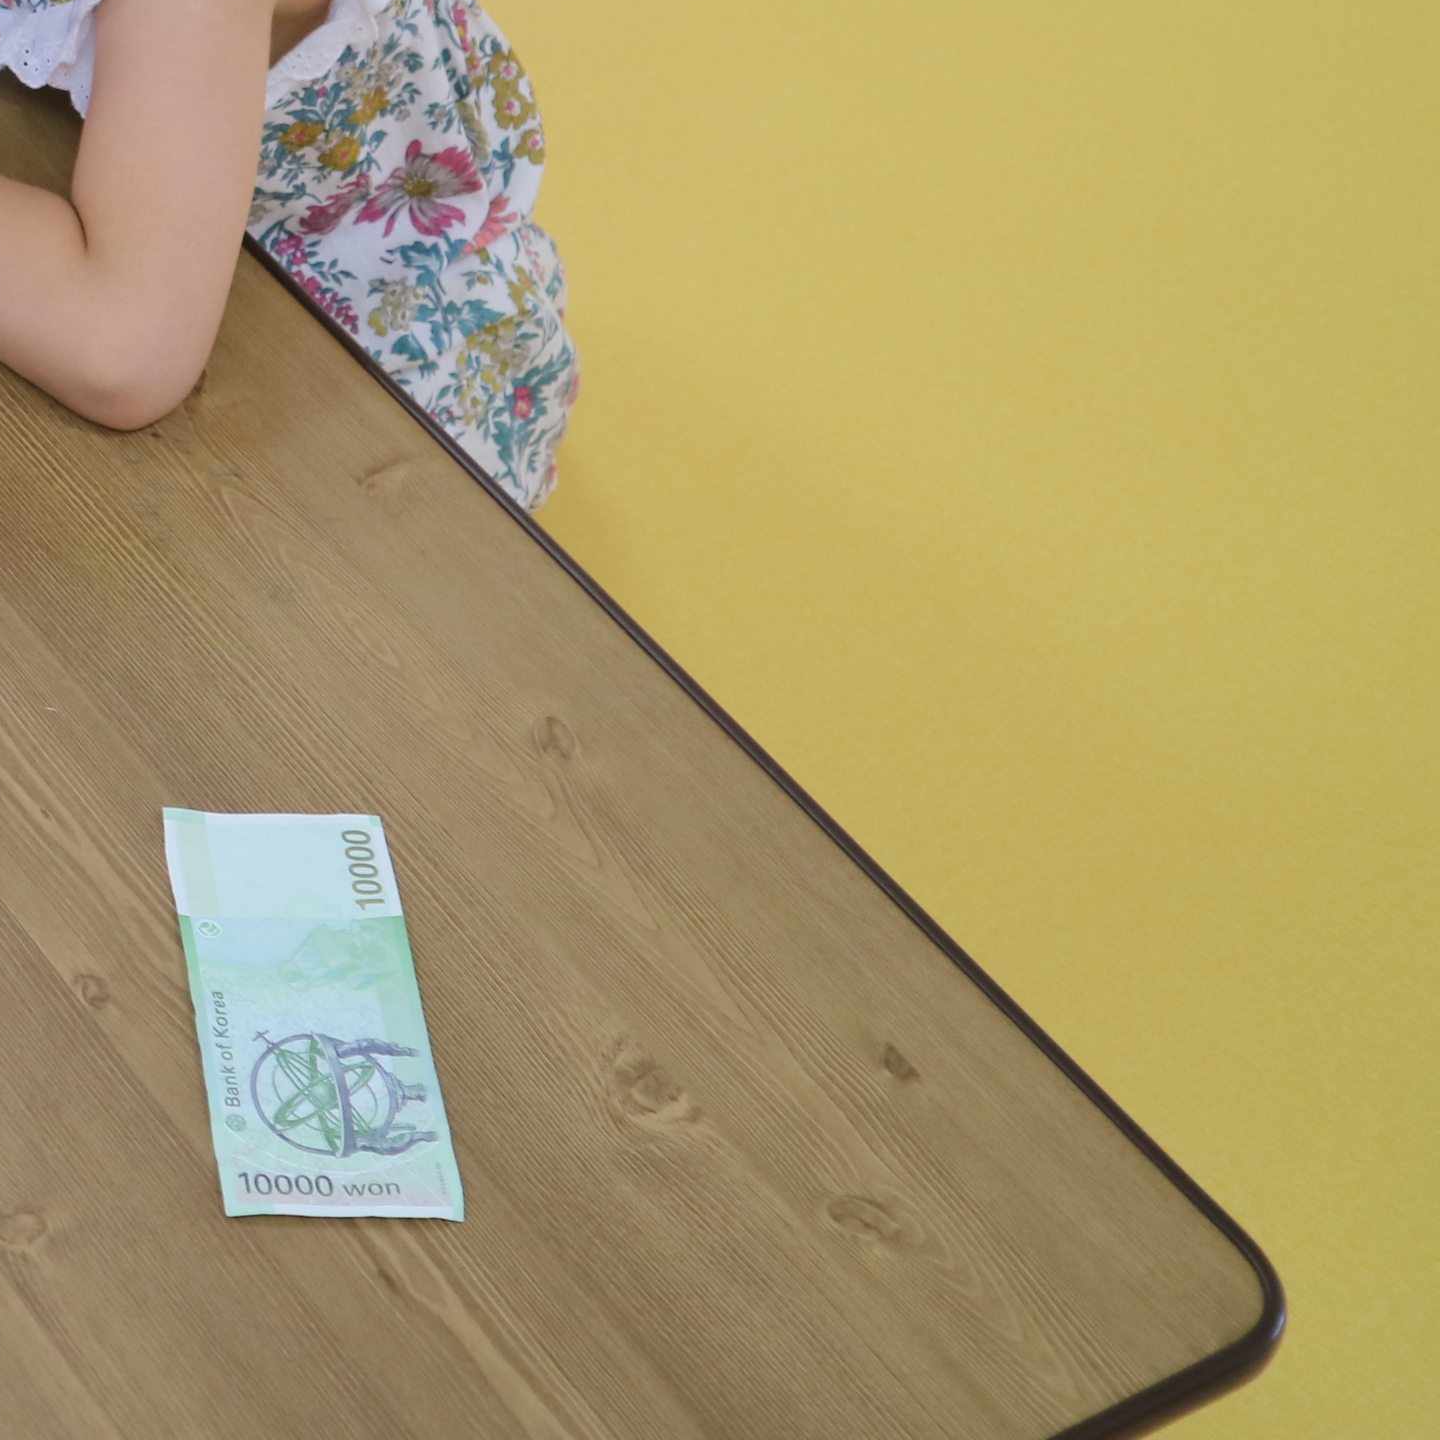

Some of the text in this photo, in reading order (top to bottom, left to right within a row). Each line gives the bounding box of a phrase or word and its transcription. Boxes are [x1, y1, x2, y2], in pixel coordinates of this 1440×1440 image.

[341, 829, 386, 911] 10000
[211, 990, 241, 1108] Bank of Korea
[238, 1172, 402, 1197] 10000 won
